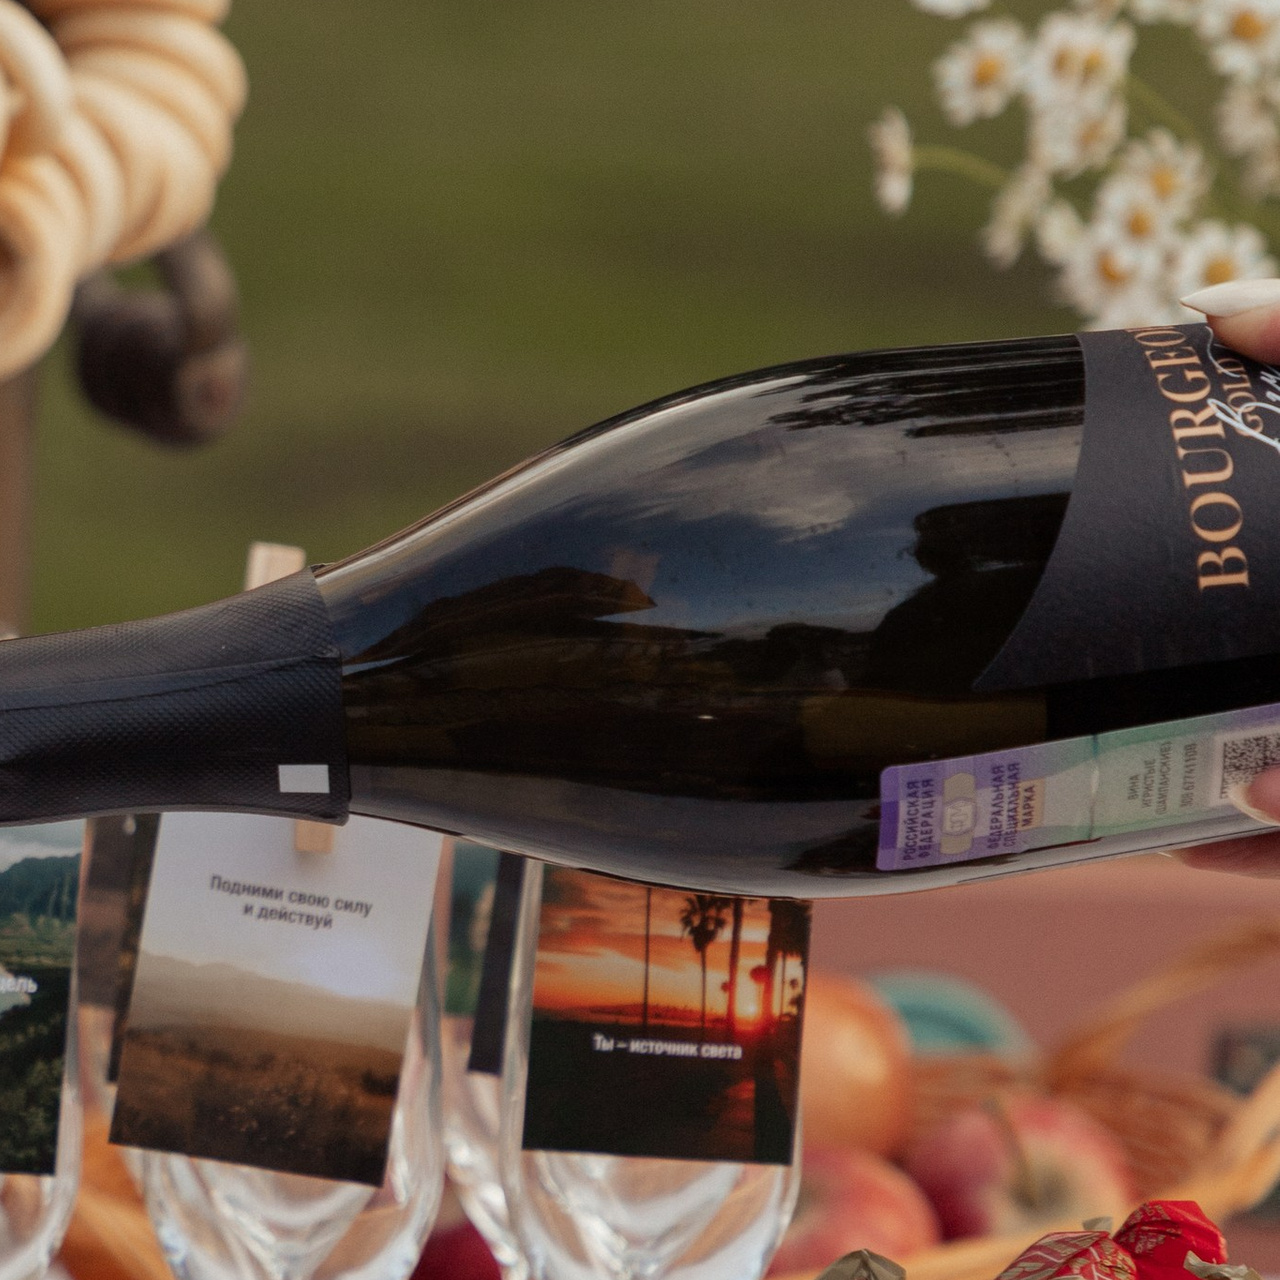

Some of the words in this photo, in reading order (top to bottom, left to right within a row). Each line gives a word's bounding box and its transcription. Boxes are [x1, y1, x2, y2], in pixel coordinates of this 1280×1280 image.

[1215, 357, 1265, 437] GOLD
[1124, 325, 1251, 593] BOURGEO
[902, 780, 920, 861] РОССИЙСКАЯ
[917, 778, 935, 859] ФЕДЕРАЦИЯ
[986, 764, 1005, 850] ФЕДЕРАЛЬНАЯ
[1002, 762, 1020, 848] СПЕЦИАЛЬНАЯ
[1021, 784, 1036, 827] МАРКА
[210, 873, 284, 900] Подними
[288, 891, 330, 909] свою
[334, 898, 373, 919] силу
[243, 903, 254, 916] и
[257, 907, 334, 930] действуй
[593, 1032, 614, 1052] Ты
[629, 1038, 700, 1058] источник
[701, 1043, 743, 1060] света
